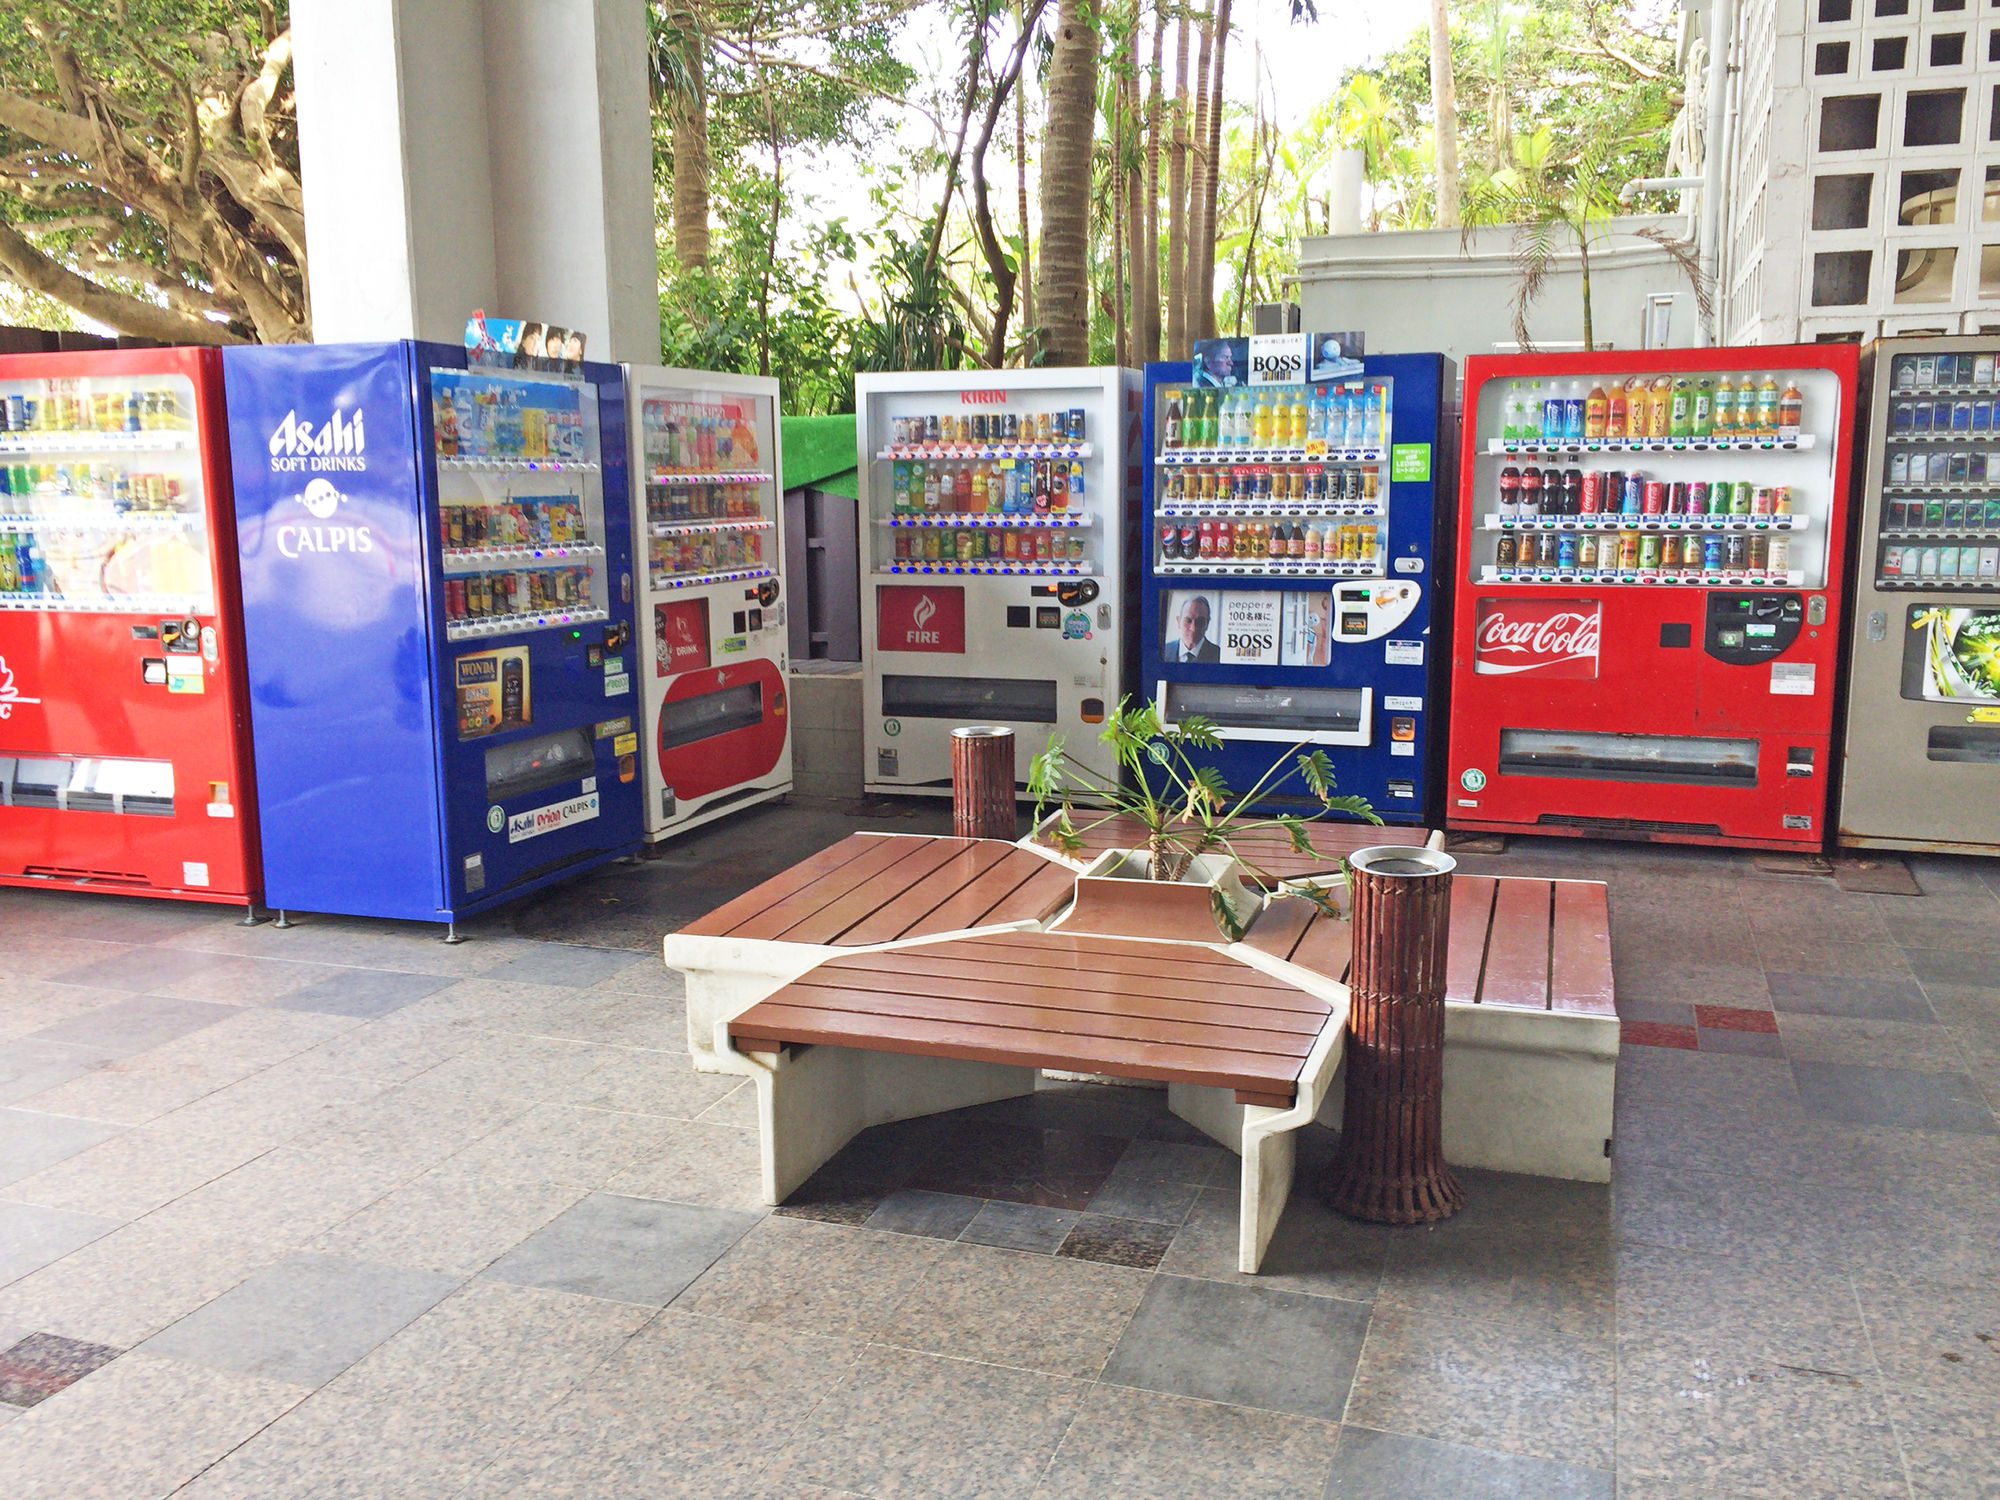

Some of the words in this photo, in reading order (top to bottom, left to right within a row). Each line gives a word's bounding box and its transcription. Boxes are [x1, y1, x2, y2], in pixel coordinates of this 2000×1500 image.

[1253, 354, 1302, 371] BOSS
[960, 390, 1006, 404] KIRIN
[269, 408, 365, 456] Asahi
[271, 457, 307, 472] SOFT
[310, 457, 366, 472] DRINKS
[277, 526, 372, 558] CALPIS
[906, 632, 940, 644] FIRE
[1478, 612, 1600, 654] Coca-Cola
[1227, 634, 1273, 650] BOSS
[676, 645, 698, 657] DRINK
[461, 661, 495, 675] WONDA
[563, 800, 589, 819] CALPIS
